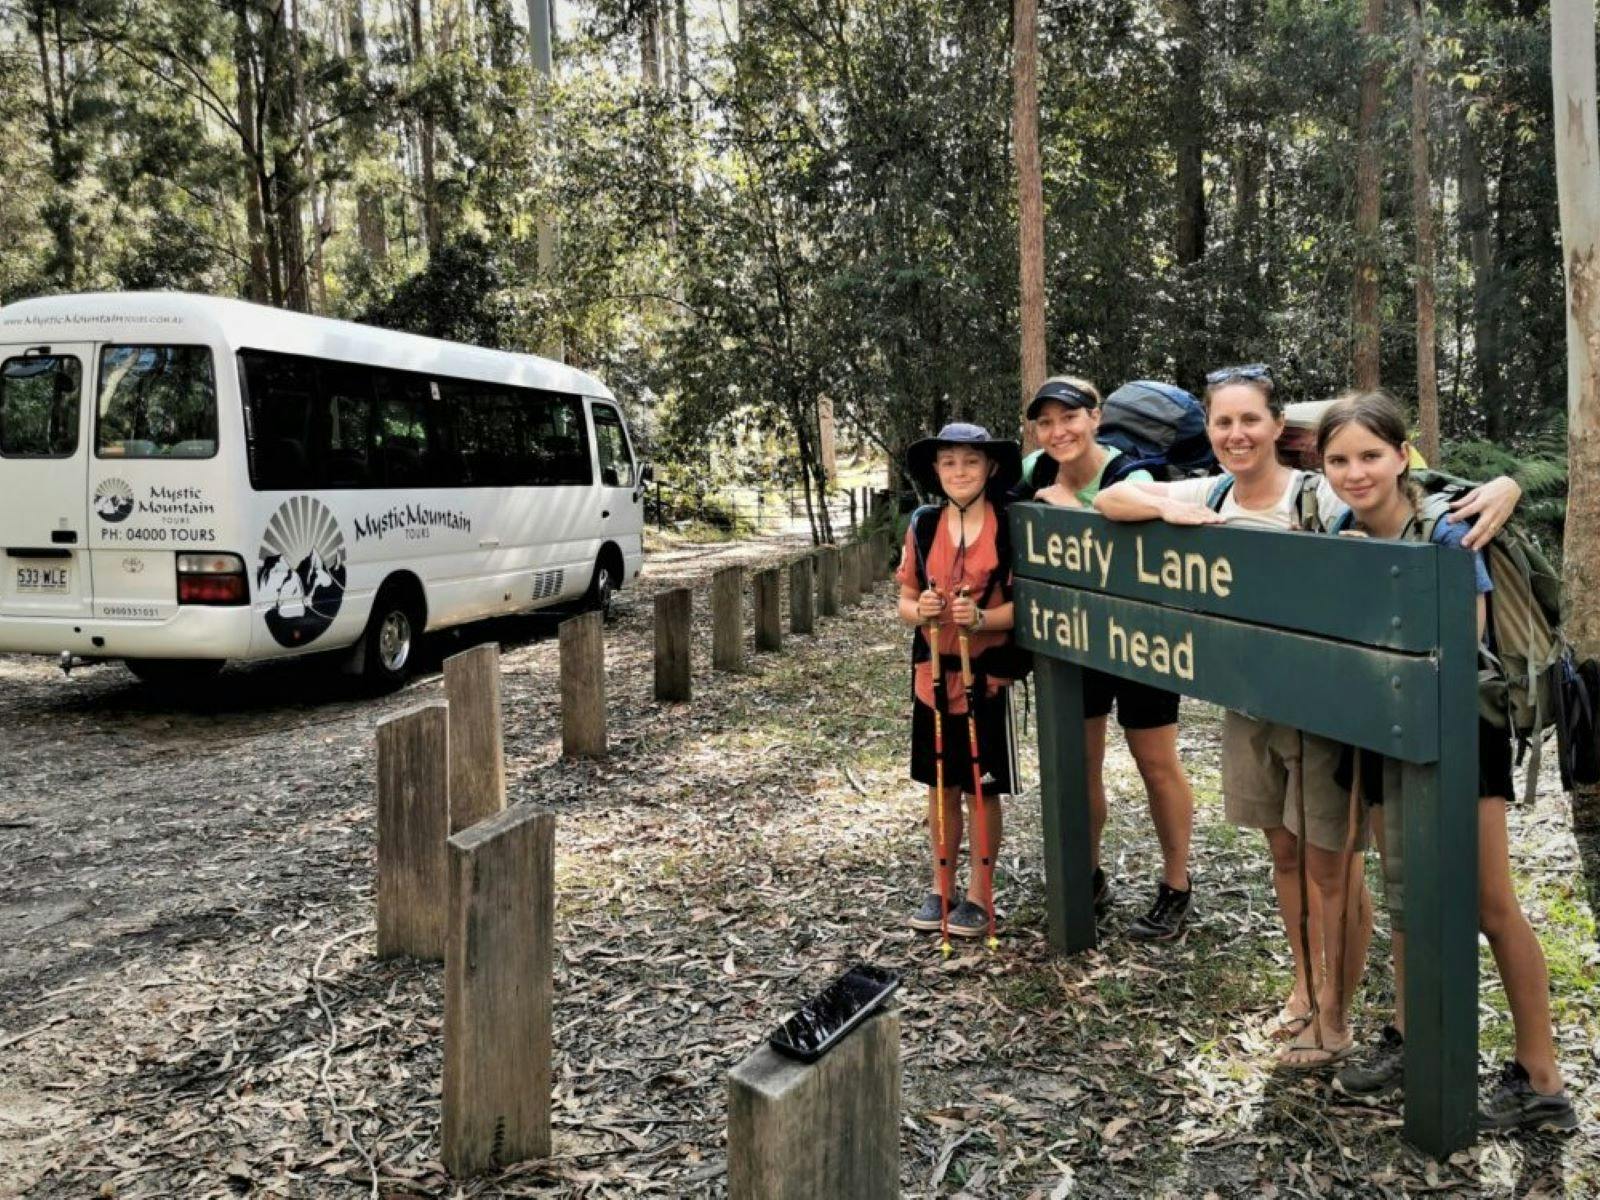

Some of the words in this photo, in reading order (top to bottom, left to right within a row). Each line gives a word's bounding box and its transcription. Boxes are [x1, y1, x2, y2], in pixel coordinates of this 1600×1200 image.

[150, 486, 202, 501] Mystic
[138, 501, 215, 514] Mountain
[161, 516, 190, 525] TOURS
[101, 528, 122, 541] PH:
[127, 528, 167, 541] 04000
[171, 528, 216, 541] TOURS
[1026, 520, 1114, 588] Leafy
[1136, 535, 1233, 598] Lane
[1030, 599, 1089, 652] trail
[1109, 616, 1194, 681] head
